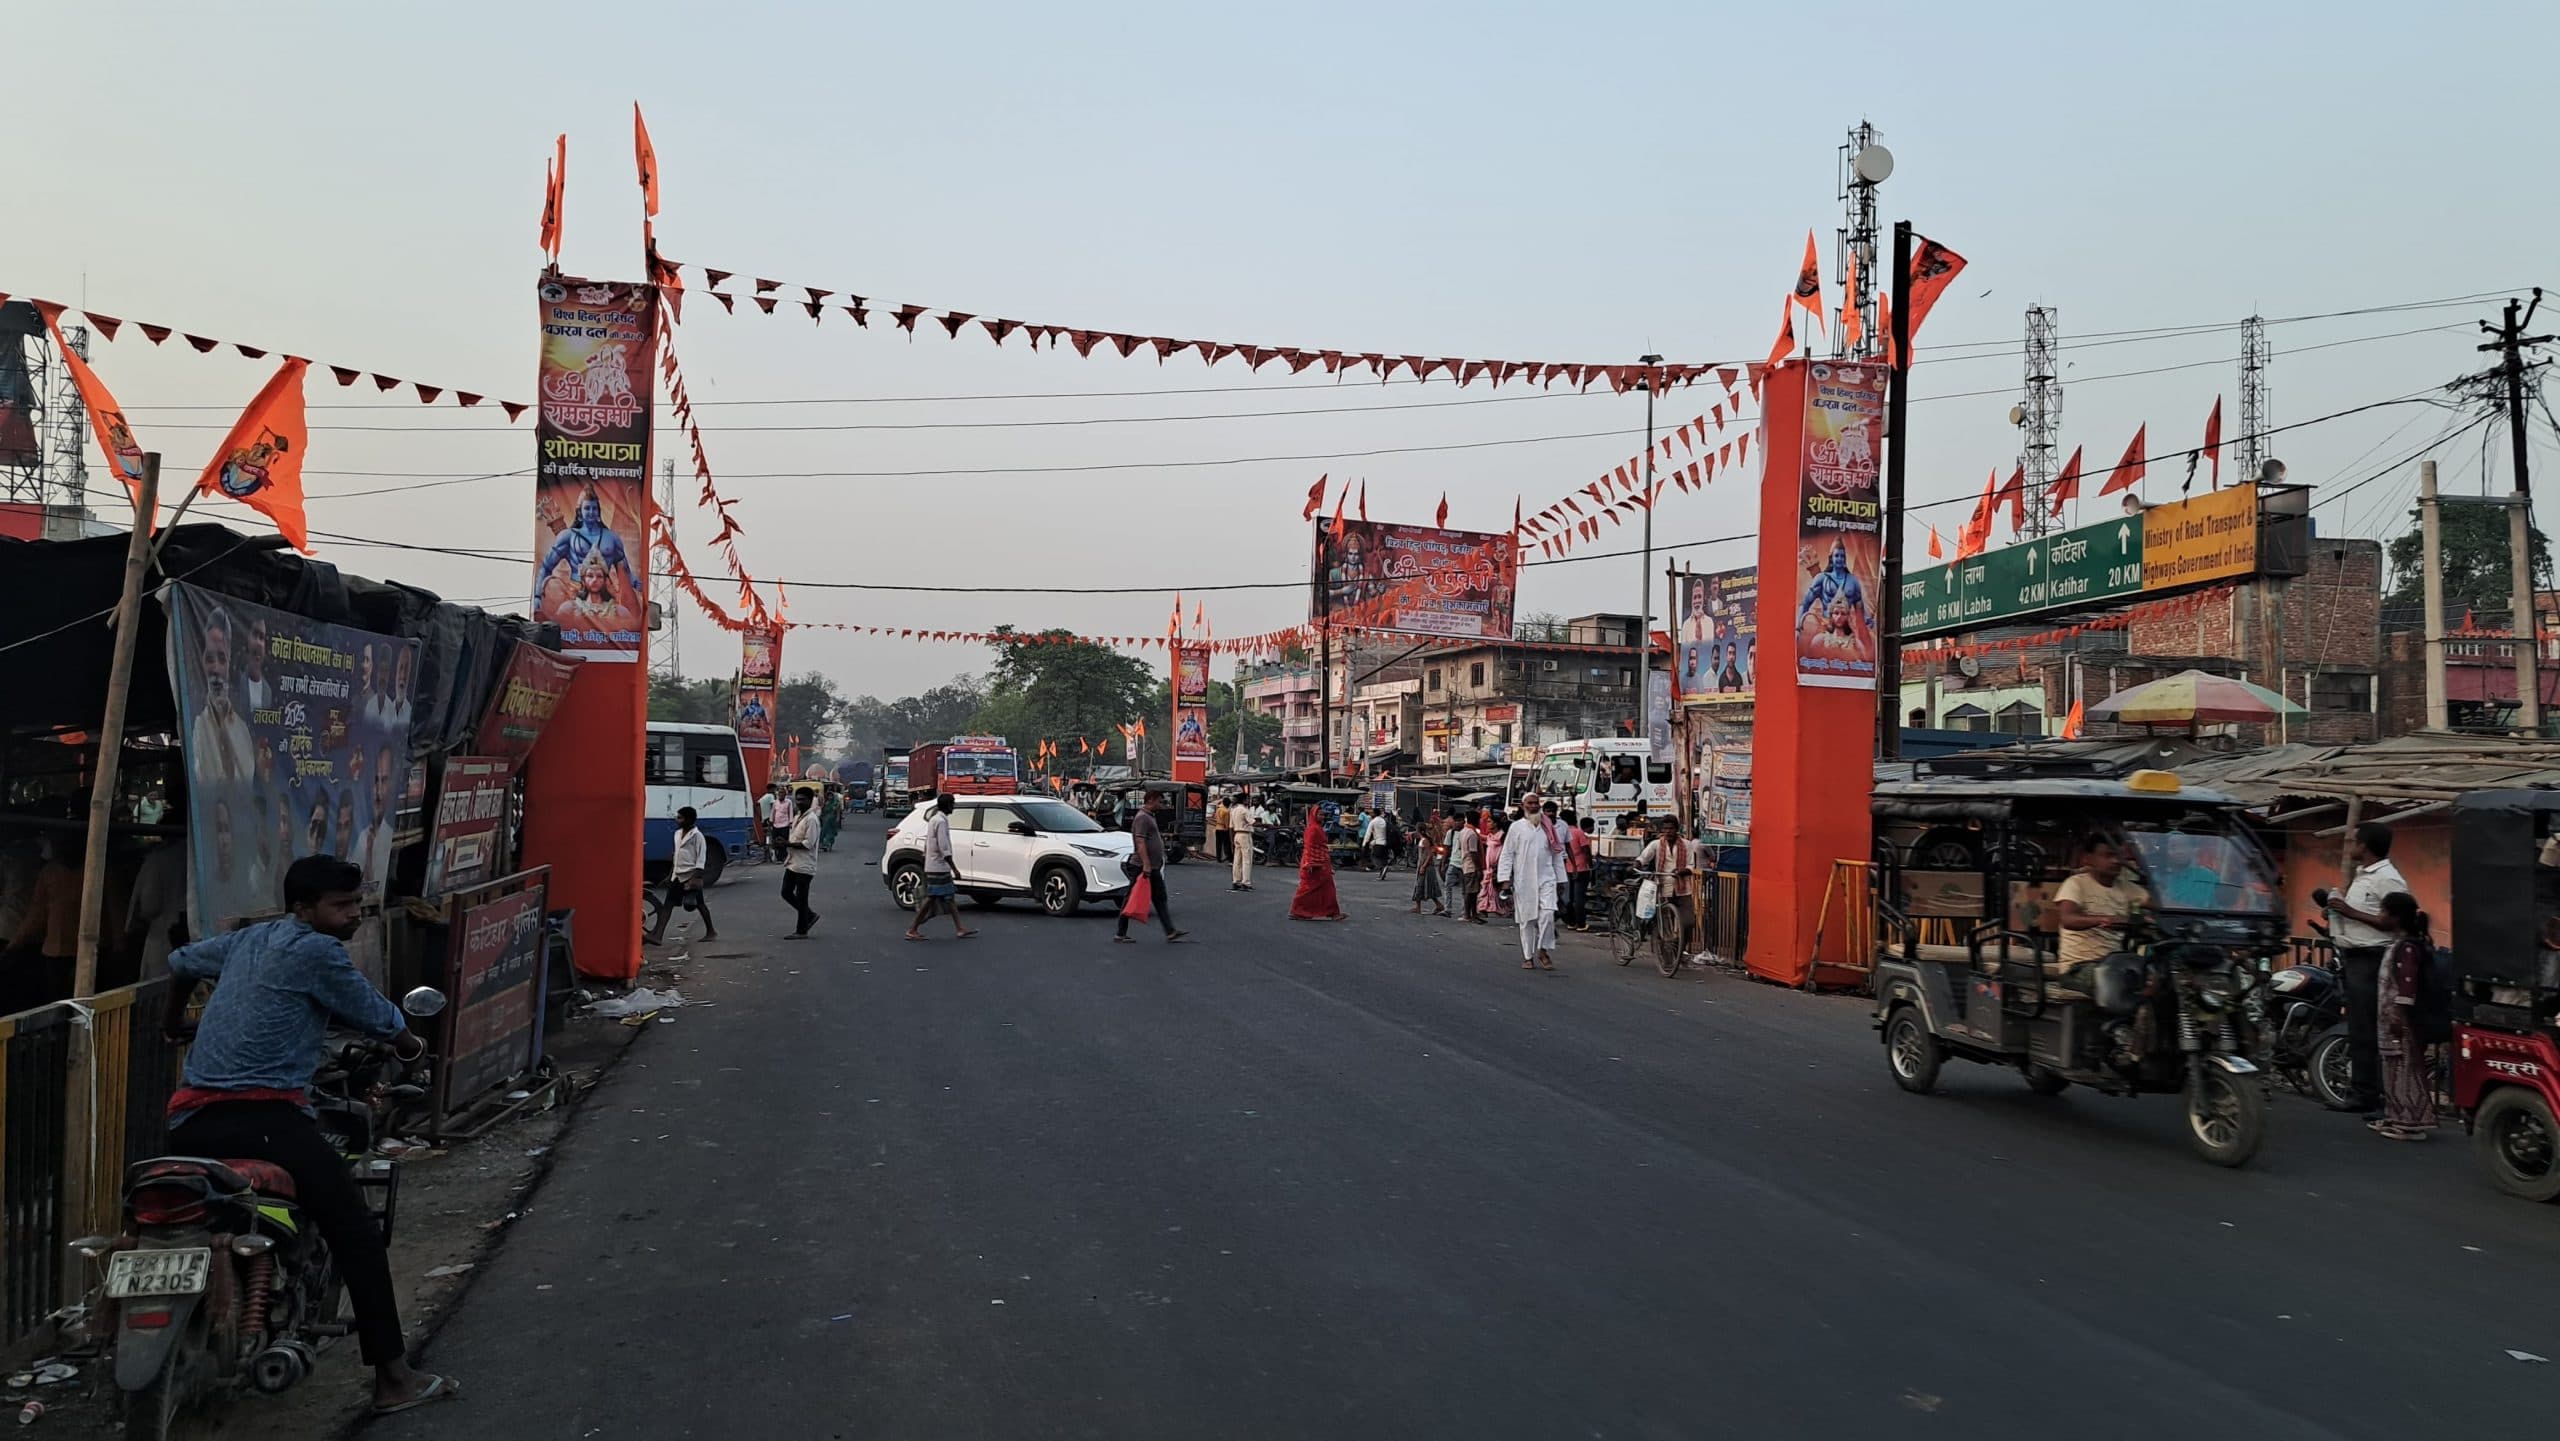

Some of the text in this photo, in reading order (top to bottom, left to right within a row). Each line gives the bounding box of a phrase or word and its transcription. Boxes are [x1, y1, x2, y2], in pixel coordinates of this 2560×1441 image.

[553, 308, 575, 321] विश्व
[577, 309, 601, 325] हिन्दू
[586, 325, 608, 339] दल
[543, 370, 586, 402] श्री
[543, 391, 644, 437] रामनवमी
[1841, 400, 1858, 413] दल
[543, 436, 642, 462] शोभायात्रा
[1809, 439, 1838, 465] श्री
[543, 462, 558, 475] की
[558, 463, 588, 477] हार्दिक
[1809, 458, 1879, 495] रामनवमी
[1807, 492, 1878, 518] शोभायात्रा
[2144, 527, 2174, 549] Ministry
[2175, 522, 2185, 537] of
[2185, 519, 2204, 540] Road
[2206, 513, 2245, 537] Transport
[2051, 537, 2088, 566] कटिहार
[2143, 540, 2254, 585] Highways Government of India
[1383, 554, 1420, 582] श्री
[1965, 565, 1985, 586] लाभा
[2108, 562, 2141, 588] 20 KM
[2019, 582, 2045, 606] 42 KM
[2050, 575, 2089, 599] Katihar
[1937, 600, 1960, 621] 66 KM
[1964, 597, 1992, 617] Labha
[470, 903, 540, 952] कटिहार पुलिस
[2484, 1058, 2545, 1078] मयूरी
[127, 1272, 197, 1293] N2305
